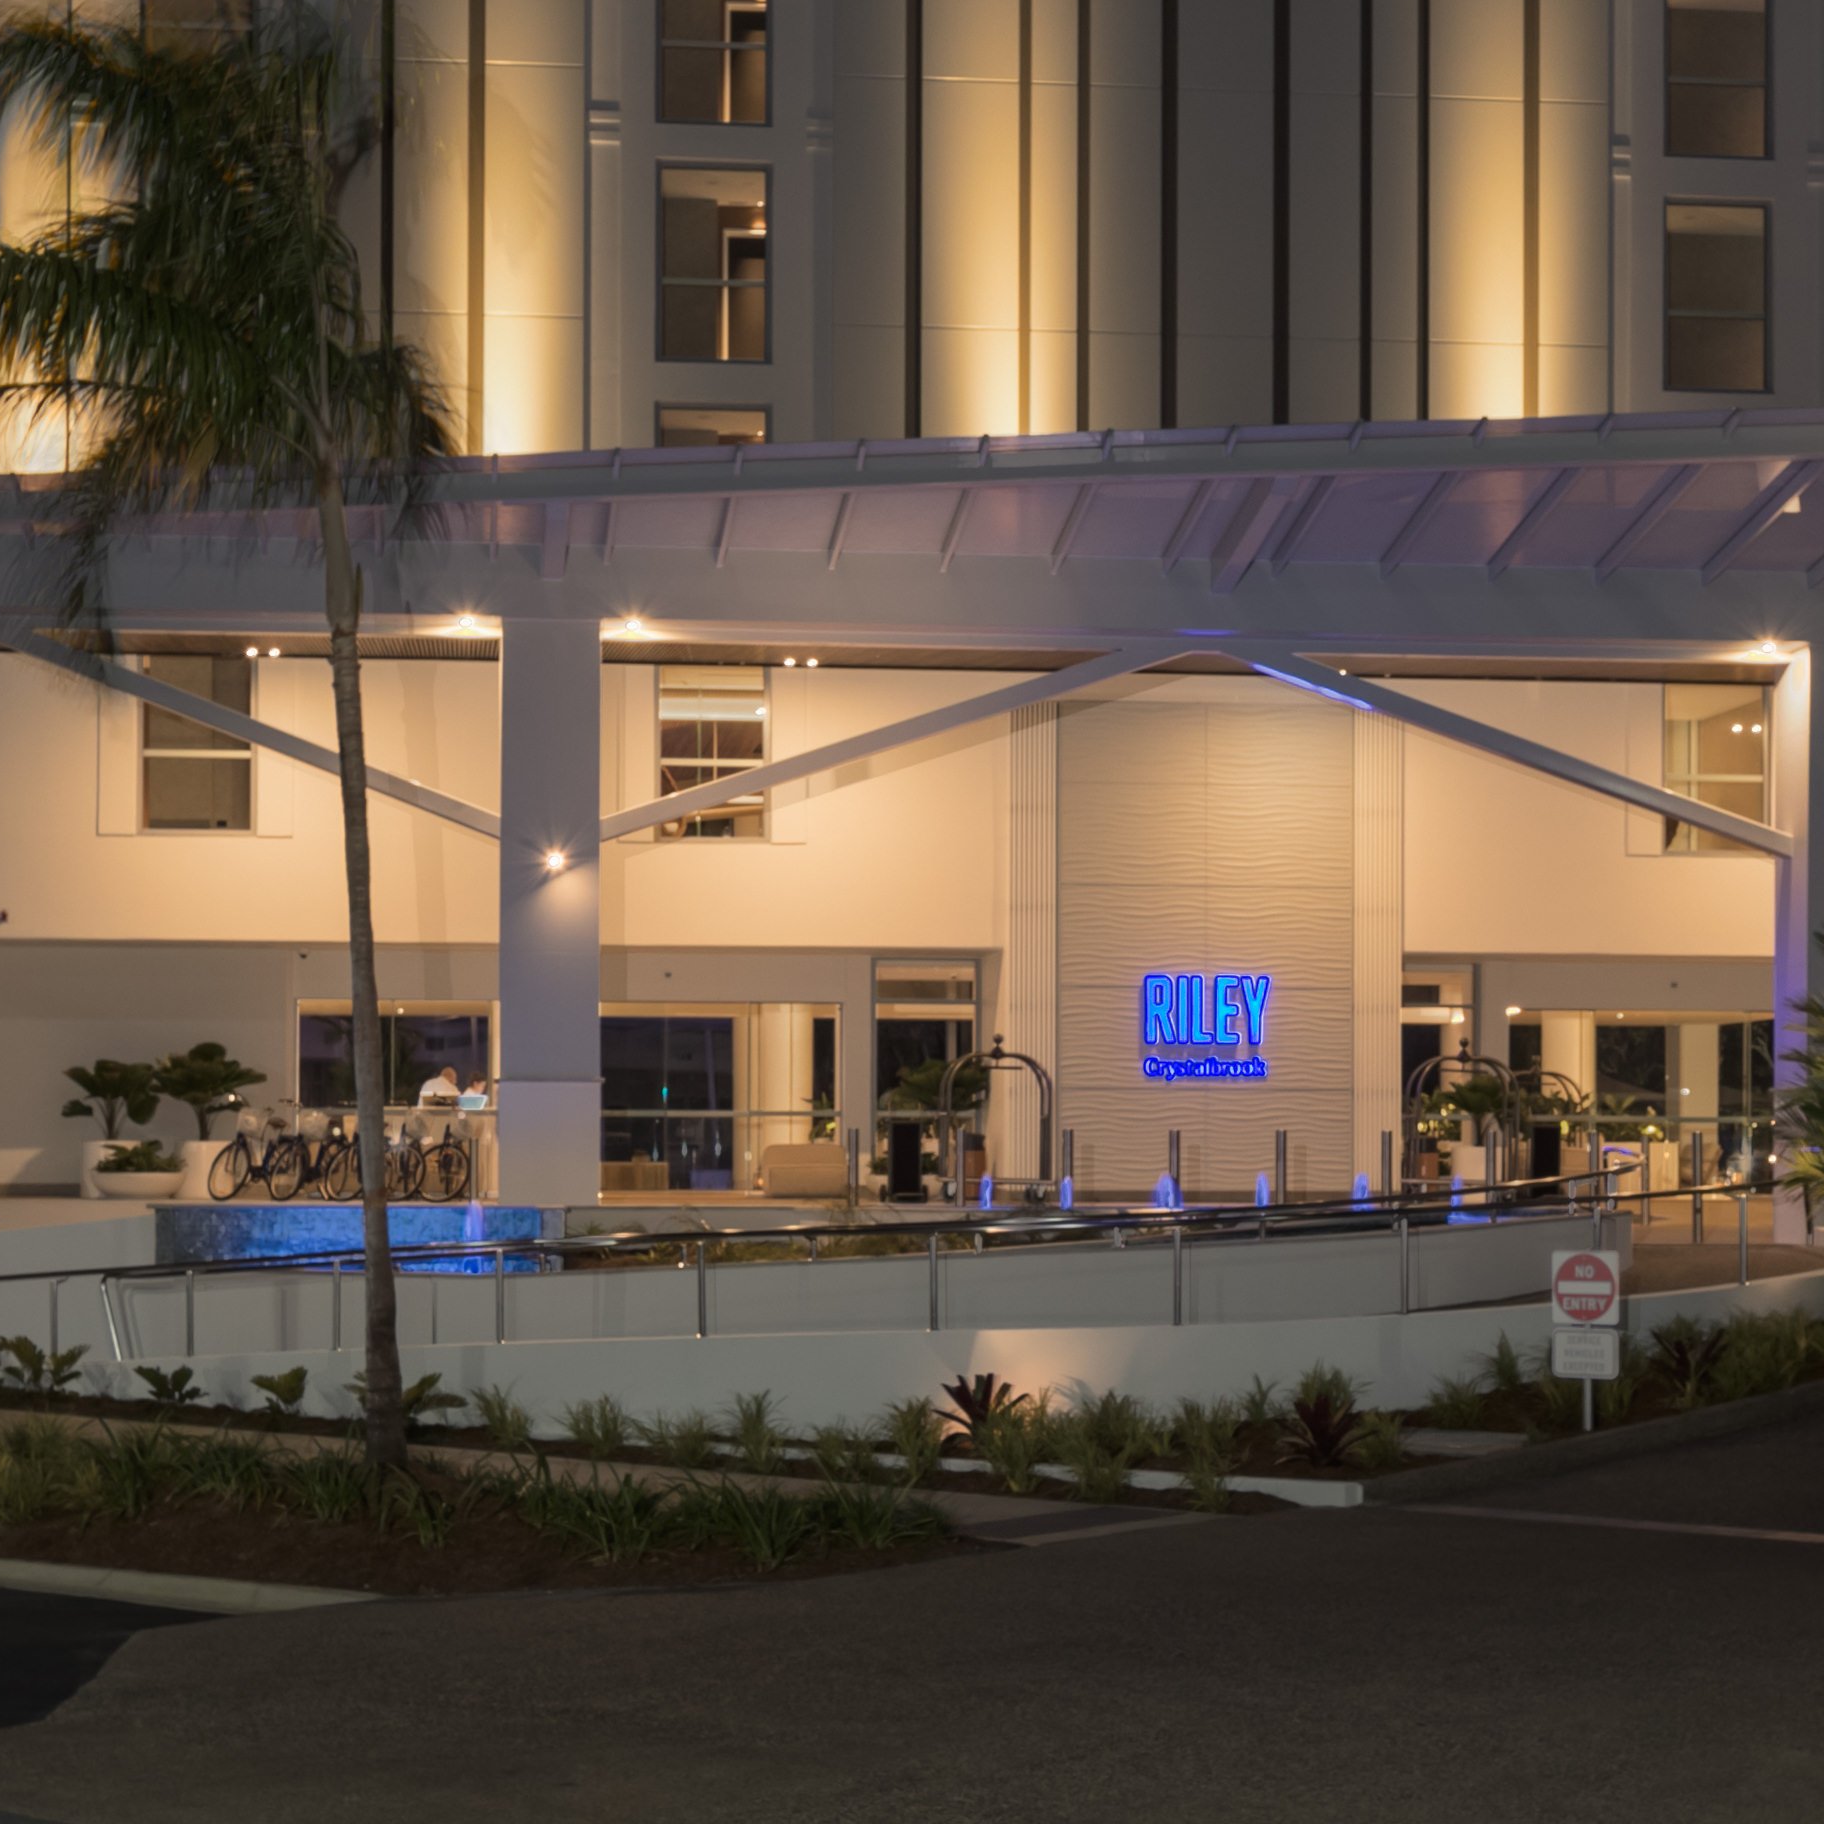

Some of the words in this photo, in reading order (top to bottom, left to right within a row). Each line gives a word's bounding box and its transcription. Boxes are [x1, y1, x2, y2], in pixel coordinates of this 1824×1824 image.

[1143, 973, 1272, 1045] RILEY
[1143, 1055, 1268, 1082] Crystalbrook
[1574, 1265, 1595, 1278] NO
[1562, 1297, 1607, 1311] ENTRY
